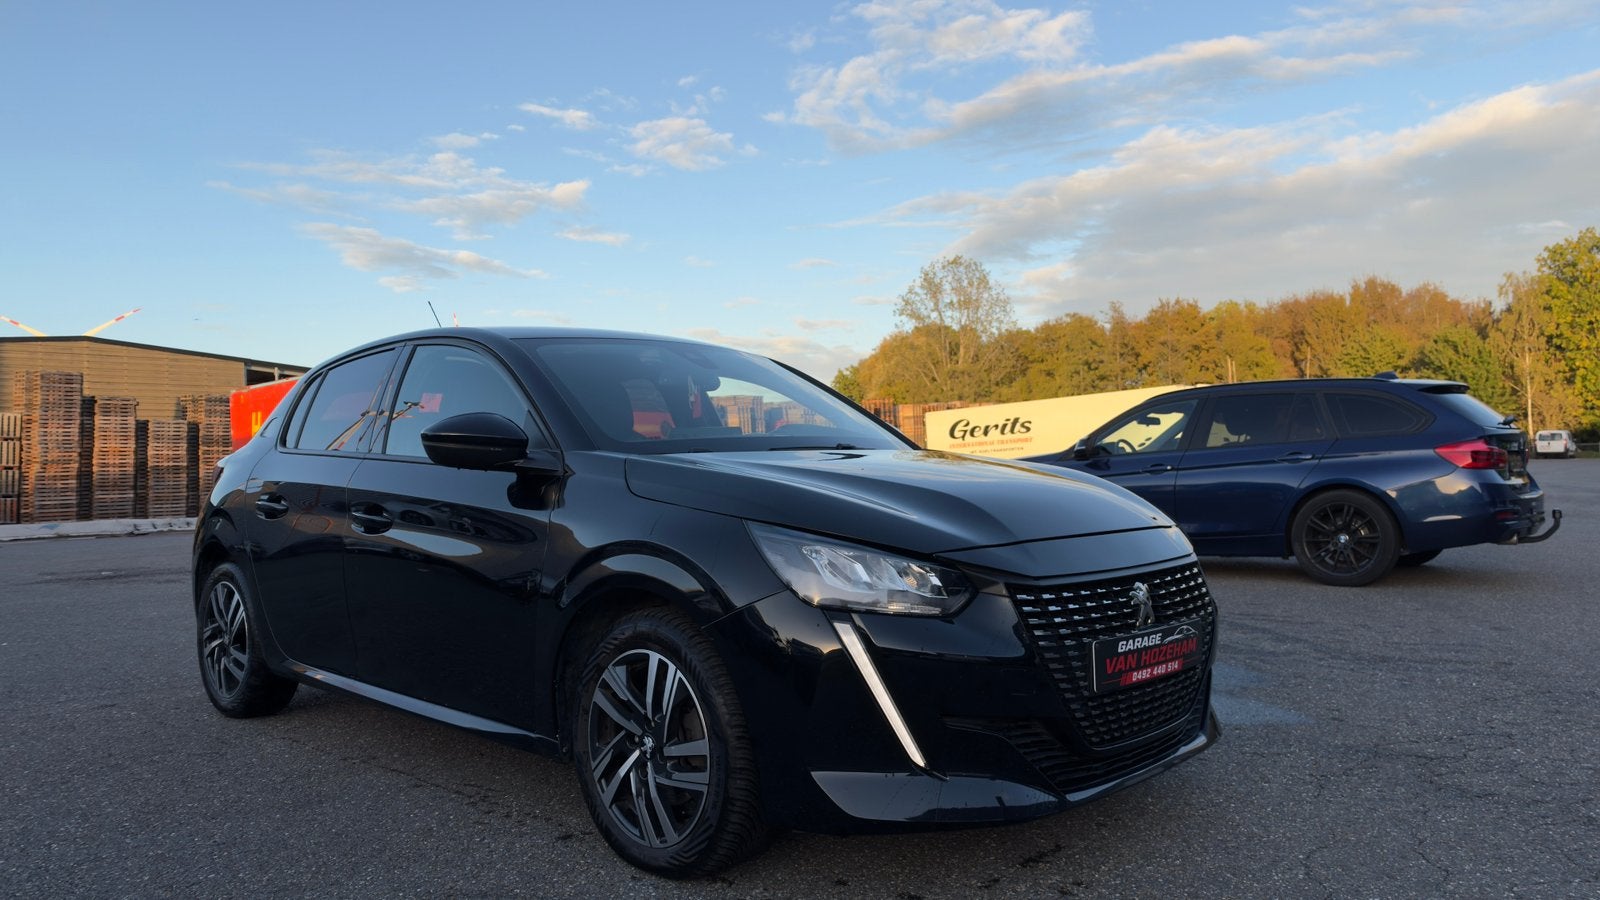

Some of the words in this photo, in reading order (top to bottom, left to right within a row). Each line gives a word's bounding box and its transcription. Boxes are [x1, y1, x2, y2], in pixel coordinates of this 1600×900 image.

[949, 417, 1032, 441] Gerits
[1117, 633, 1163, 653] GARAGE
[1105, 652, 1138, 674] VAN
[1140, 637, 1198, 666] HOZEHAM
[1132, 668, 1151, 681] 0492
[1152, 664, 1166, 675] 440
[1167, 661, 1179, 672] 514
